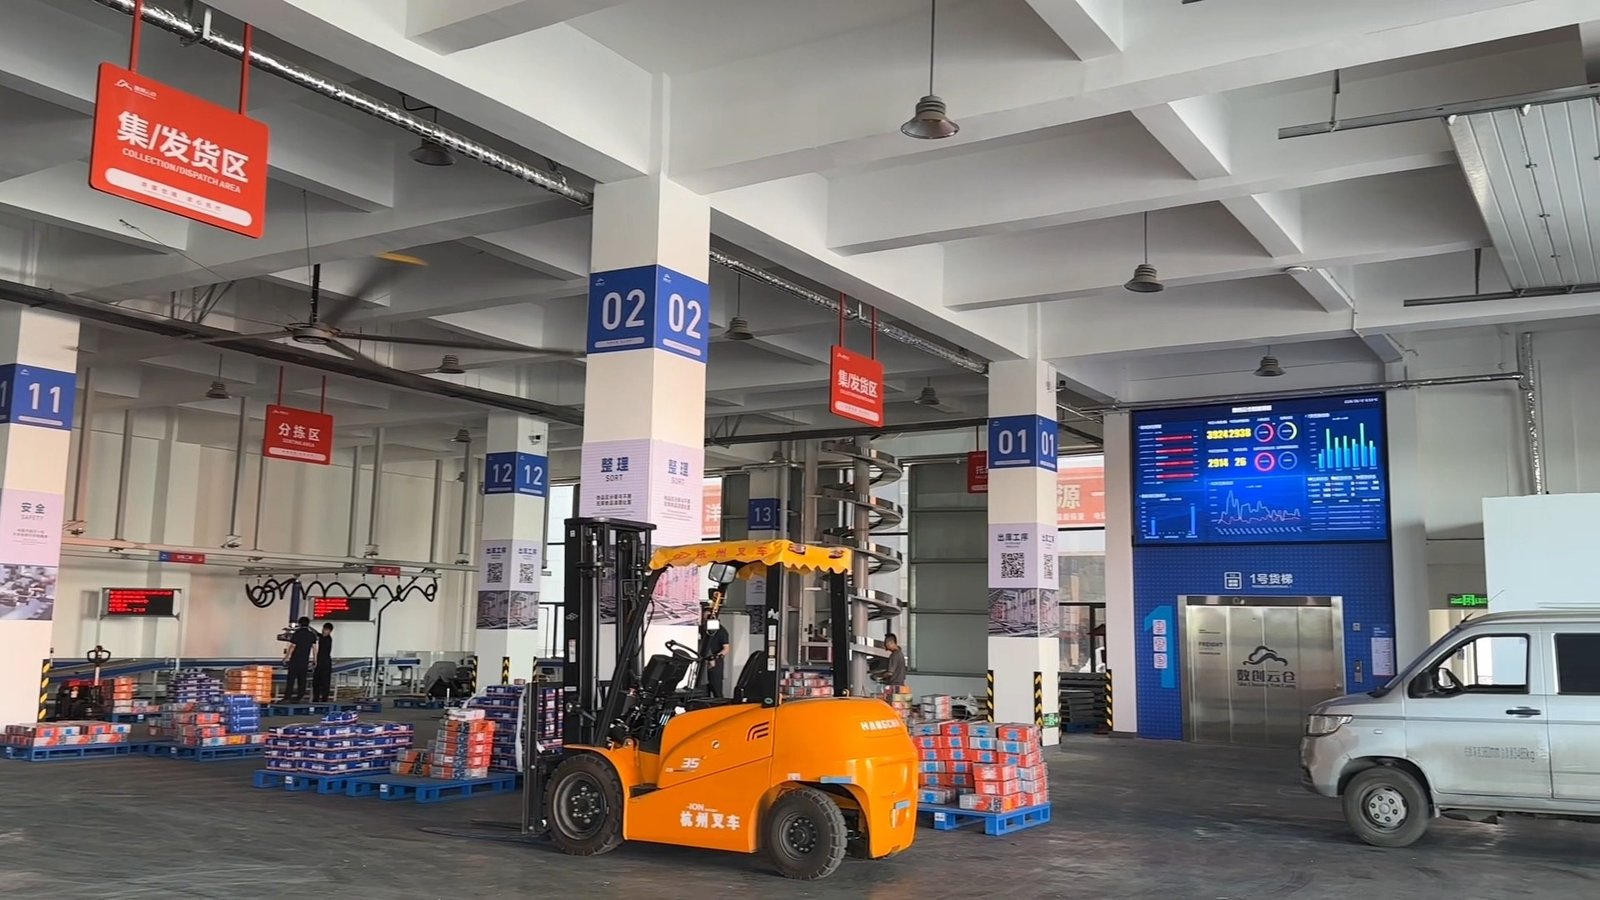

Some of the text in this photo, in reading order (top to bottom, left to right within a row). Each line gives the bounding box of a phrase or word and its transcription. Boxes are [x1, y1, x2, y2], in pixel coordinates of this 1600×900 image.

[116, 110, 249, 183] 集/发货区
[122, 148, 241, 194] COLLECTION/DISPATCH AREA
[602, 289, 646, 331] 02
[668, 293, 702, 339] 02
[837, 368, 879, 399] 集/发货区
[29, 382, 61, 414] 11
[278, 422, 321, 442] 分拣区
[998, 429, 1027, 455] 01
[1041, 430, 1054, 458] 01
[492, 463, 513, 483] 12
[601, 456, 629, 473] 整理
[667, 459, 689, 477] 整理
[524, 464, 544, 486] 12
[605, 474, 624, 482] SORT
[21, 502, 46, 514] 安全
[754, 506, 771, 522] 13
[695, 546, 769, 559] 杭州叉车
[1249, 573, 1293, 585] 1号货梯
[1236, 669, 1296, 684] 数创云仓
[680, 757, 701, 769] 35
[680, 810, 741, 831] 杭州叉车
